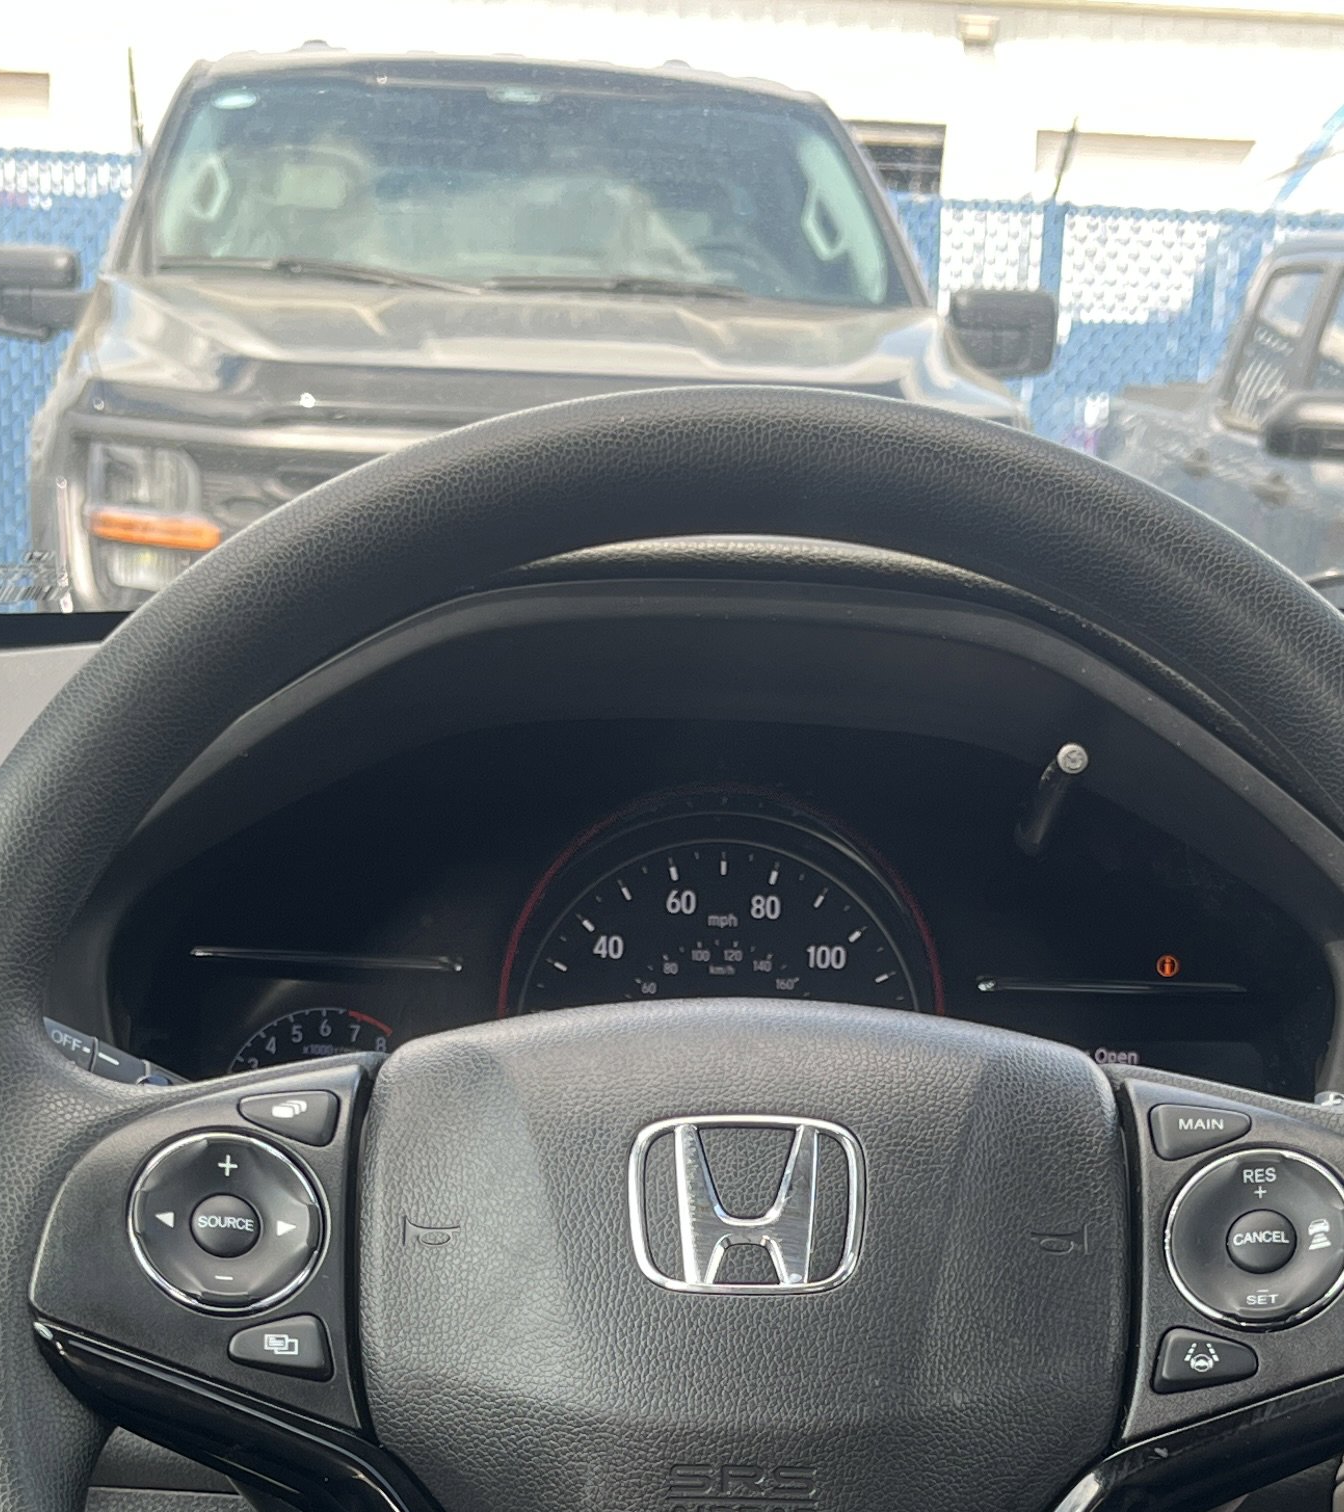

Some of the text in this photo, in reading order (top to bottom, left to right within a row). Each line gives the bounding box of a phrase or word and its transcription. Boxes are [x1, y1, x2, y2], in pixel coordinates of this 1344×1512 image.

[665, 889, 697, 915] 60
[750, 895, 781, 920] 80
[707, 914, 739, 929] mph
[593, 935, 624, 960] 40
[806, 945, 847, 970] 100
[291, 1025, 304, 1043] 5
[319, 1020, 332, 1037] 6
[348, 1025, 362, 1042] 7
[50, 1029, 83, 1052] OFF
[265, 1038, 278, 1055] 4
[1094, 1048, 1139, 1065] Open
[1178, 1118, 1224, 1131] MAIN
[1242, 1167, 1277, 1184] RES
[197, 1215, 254, 1232] SOURCE
[1233, 1230, 1290, 1247] CANCEL
[1246, 1293, 1278, 1305] SET
[667, 1463, 817, 1500] SRS
